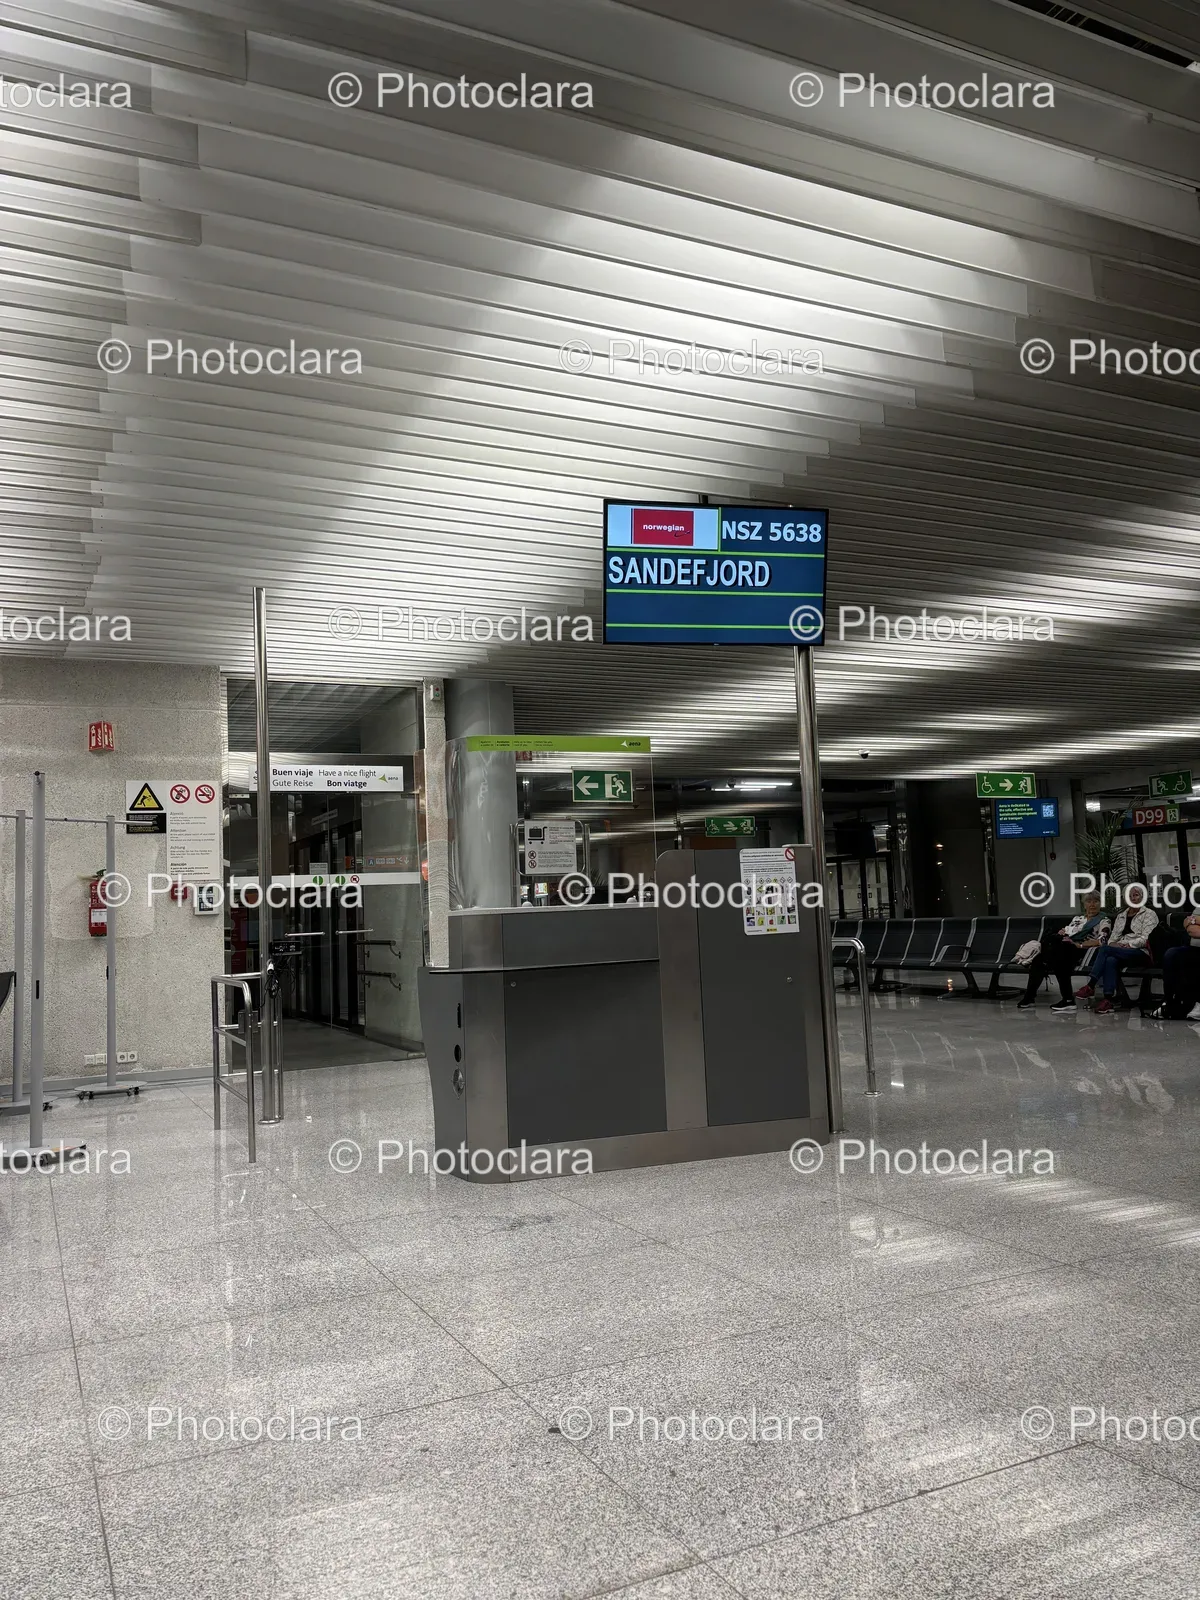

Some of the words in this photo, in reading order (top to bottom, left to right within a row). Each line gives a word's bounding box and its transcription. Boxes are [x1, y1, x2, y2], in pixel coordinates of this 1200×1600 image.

[643, 524, 684, 532] norwegian
[722, 521, 762, 540] NSZ
[769, 523, 821, 542] 5638
[609, 556, 770, 587] SANDEFJORD
[294, 769, 313, 778] viaje
[359, 769, 376, 778] flight
[344, 780, 367, 789] viatge
[1136, 808, 1164, 825] D99
